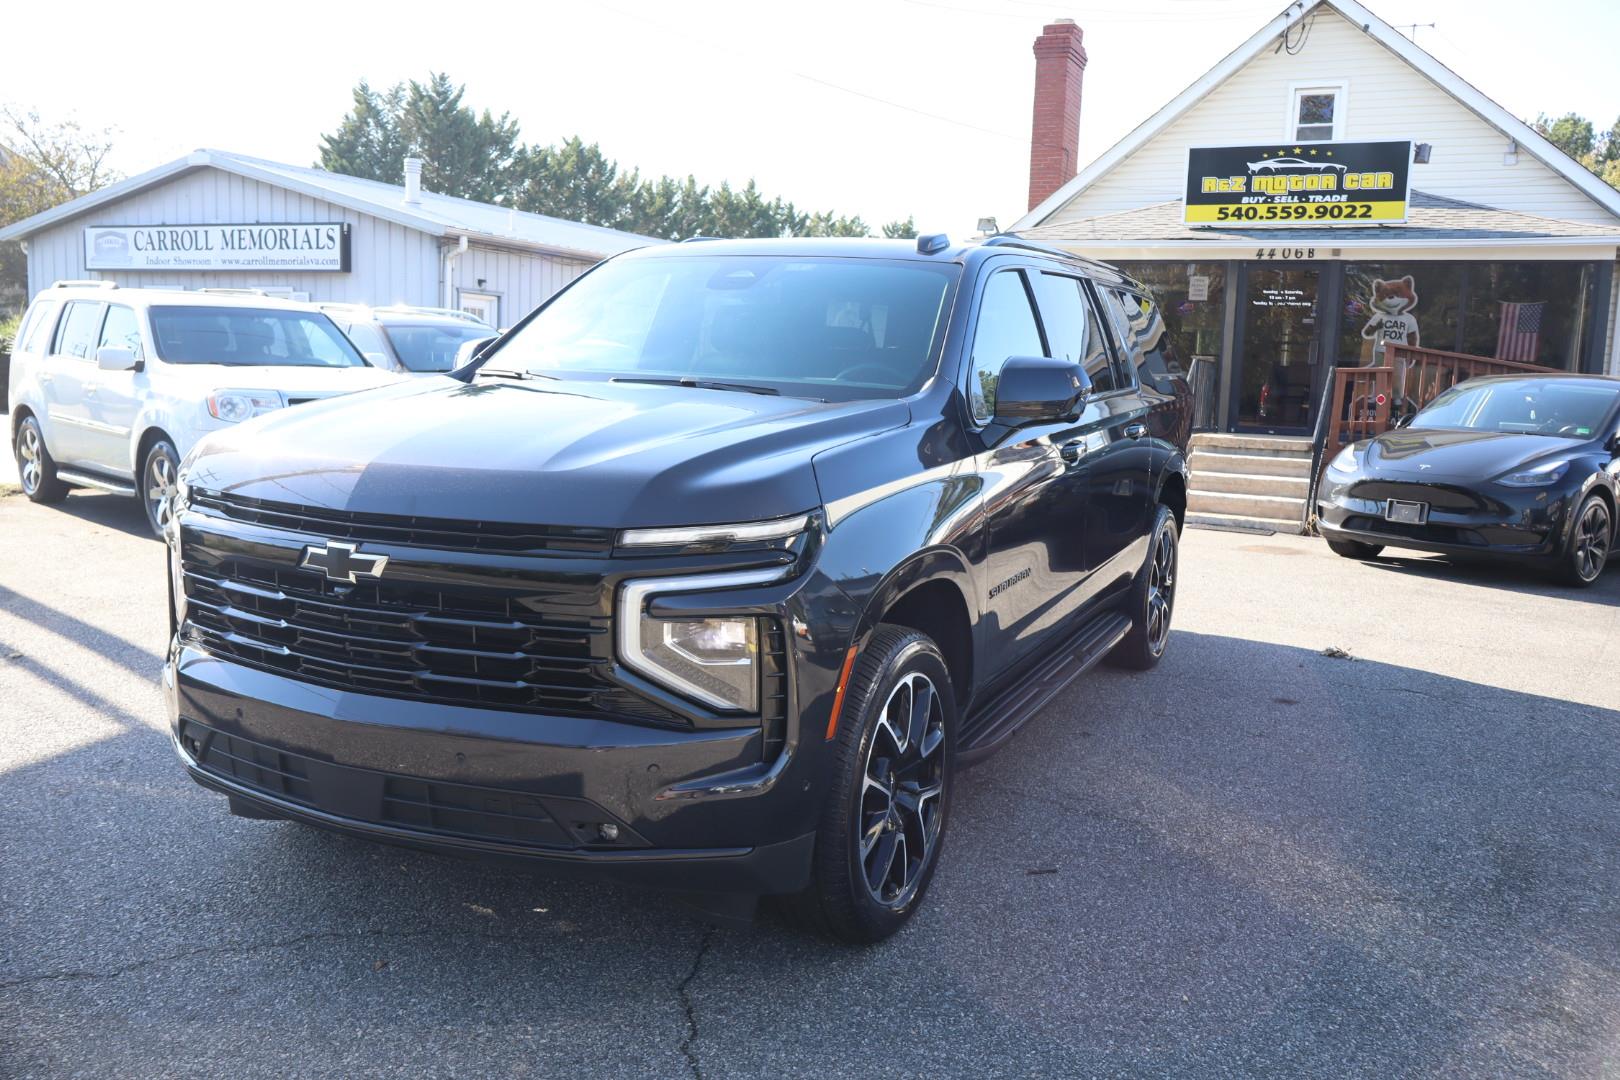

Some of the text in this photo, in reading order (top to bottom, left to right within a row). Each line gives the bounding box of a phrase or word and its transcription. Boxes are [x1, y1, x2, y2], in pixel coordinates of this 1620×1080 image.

[1251, 173, 1337, 195] MOTOR
[1241, 194, 1348, 204] BUY SELL TRADE
[1216, 204, 1373, 221] 540.559.9022
[133, 228, 336, 251] CARROLL MEMORIALS
[145, 255, 340, 266] Indoor Showroom www.carrollmemorialsva.com
[1384, 320, 1406, 331] CAR
[1383, 330, 1405, 341] FOX
